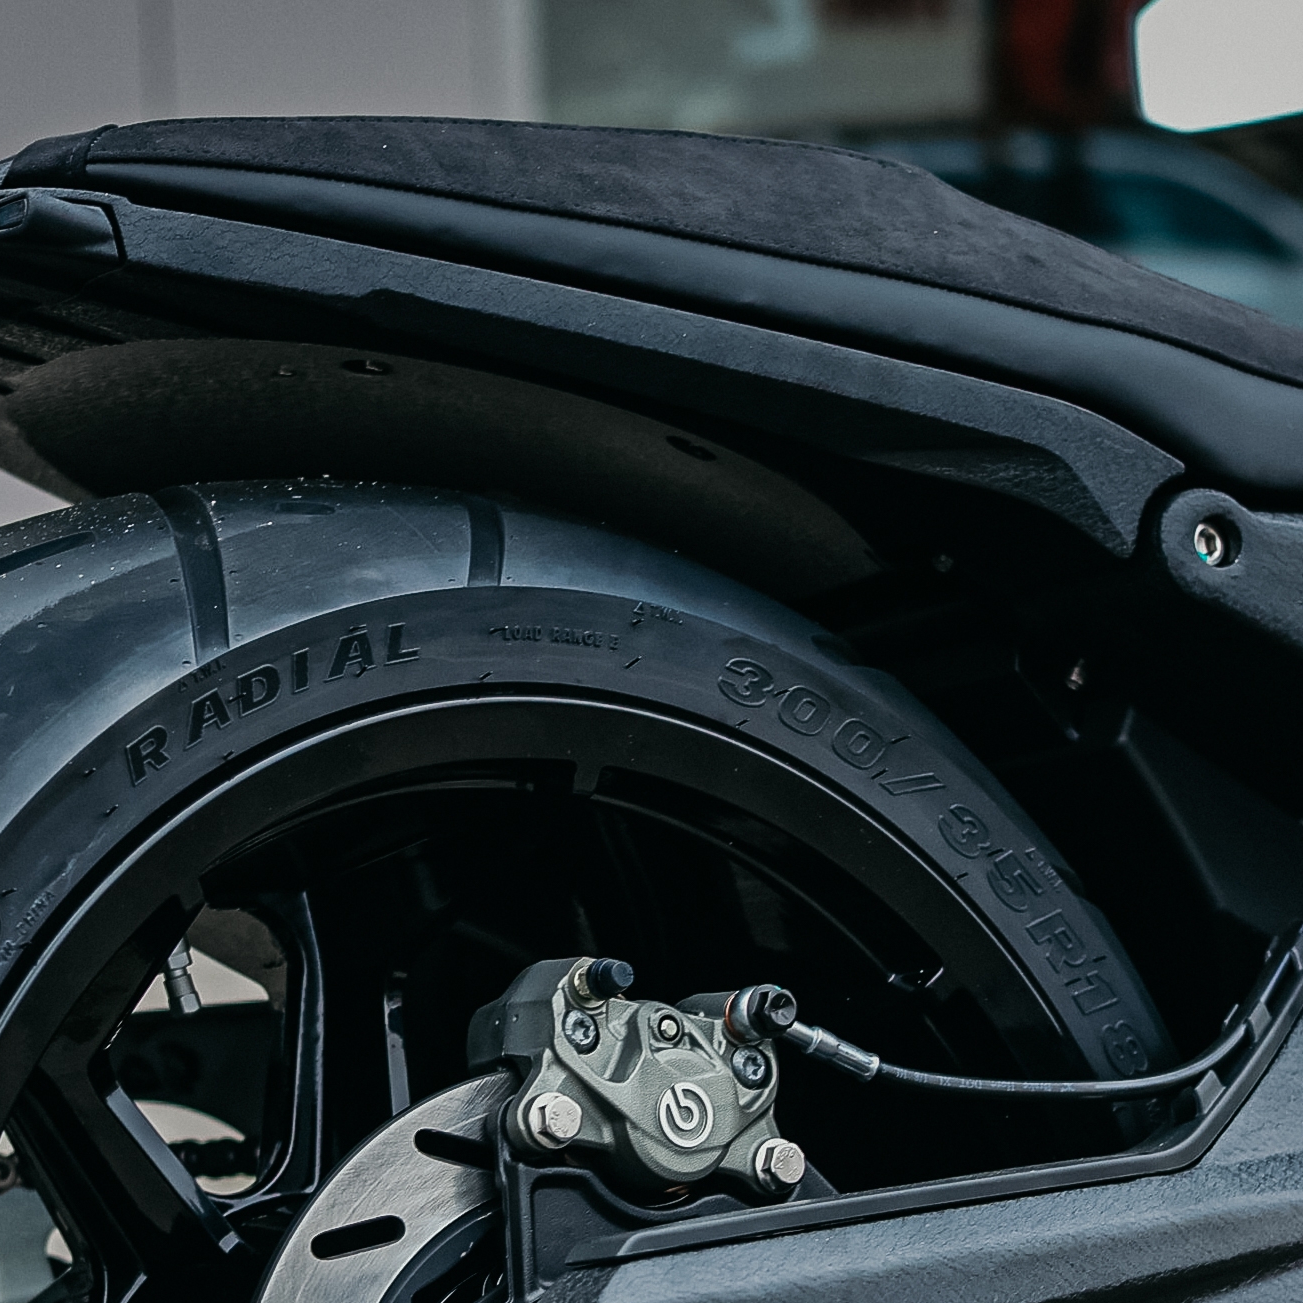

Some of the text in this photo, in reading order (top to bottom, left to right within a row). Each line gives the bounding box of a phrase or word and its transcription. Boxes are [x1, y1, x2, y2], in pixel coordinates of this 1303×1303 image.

[502, 623, 544, 642] LOAD
[550, 626, 605, 648] RANGE
[125, 621, 422, 788] RADIAL
